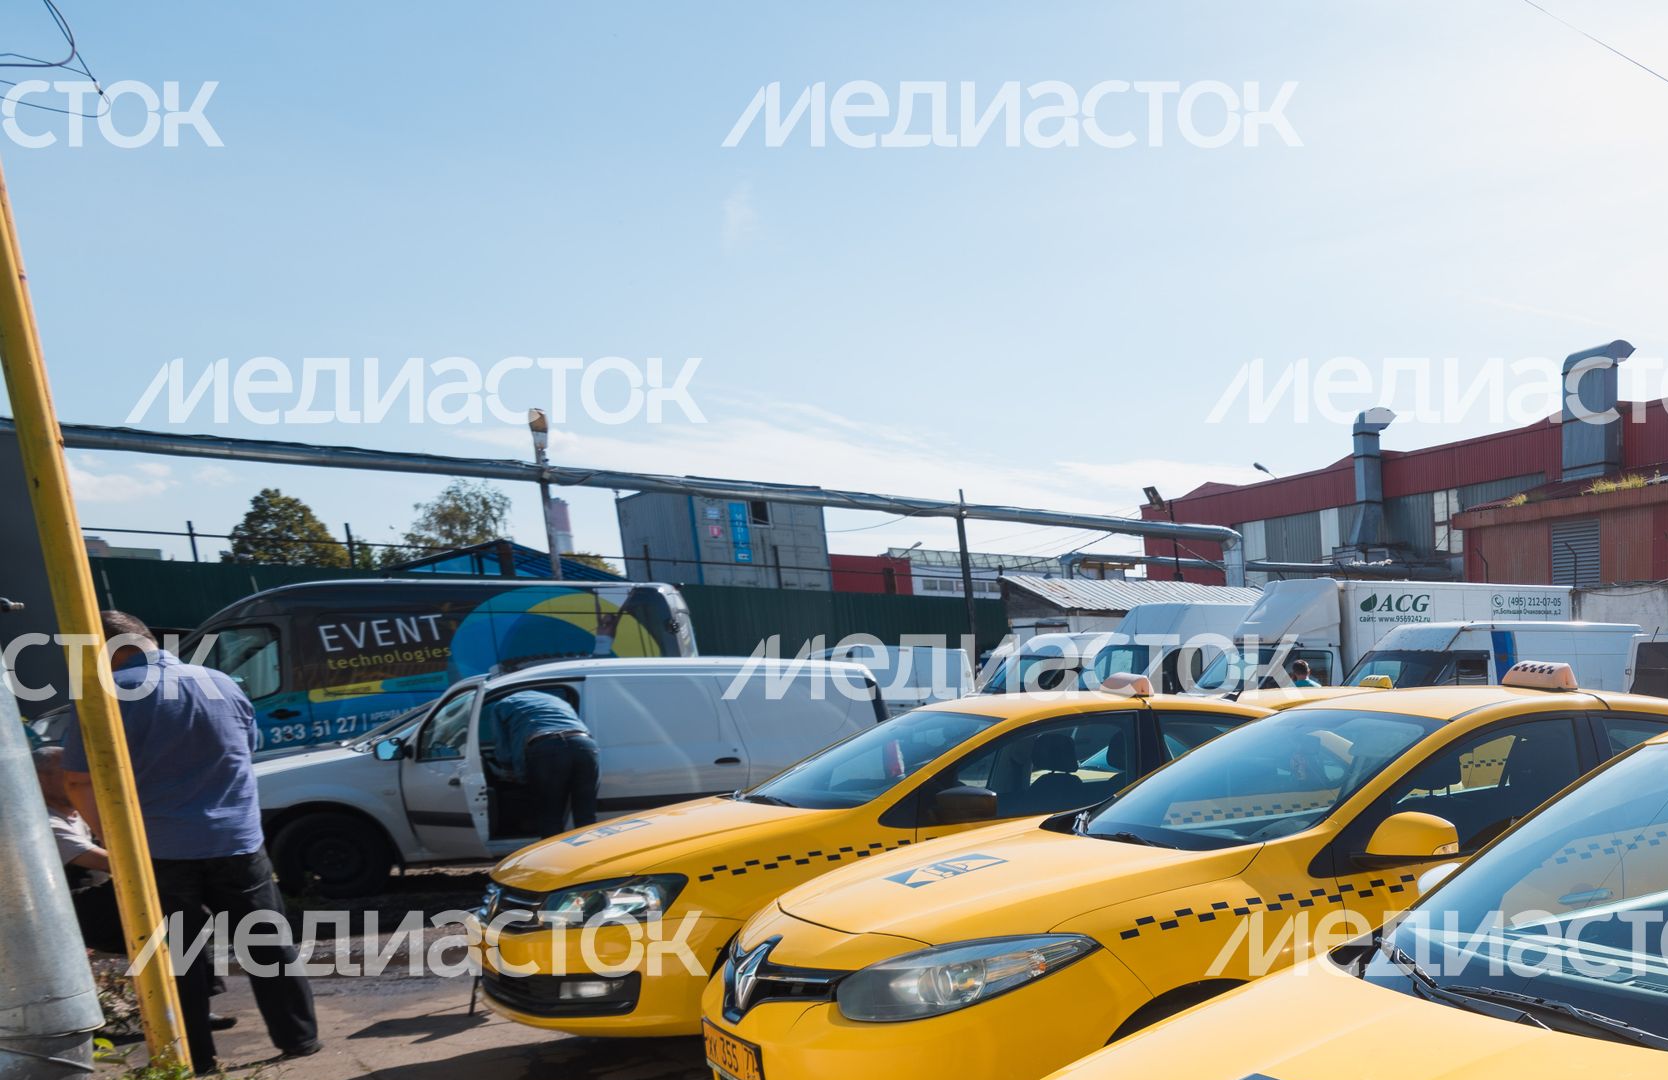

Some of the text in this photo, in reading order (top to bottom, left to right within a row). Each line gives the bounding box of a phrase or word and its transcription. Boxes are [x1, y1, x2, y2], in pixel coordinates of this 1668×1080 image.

[1377, 594, 1430, 612] ACG
[1508, 597, 1561, 608] (495) 212-07-05
[318, 614, 443, 652] EVENT
[327, 646, 452, 670] technologies
[270, 723, 306, 744] 333
[311, 719, 331, 738] 51
[337, 715, 357, 734] 27
